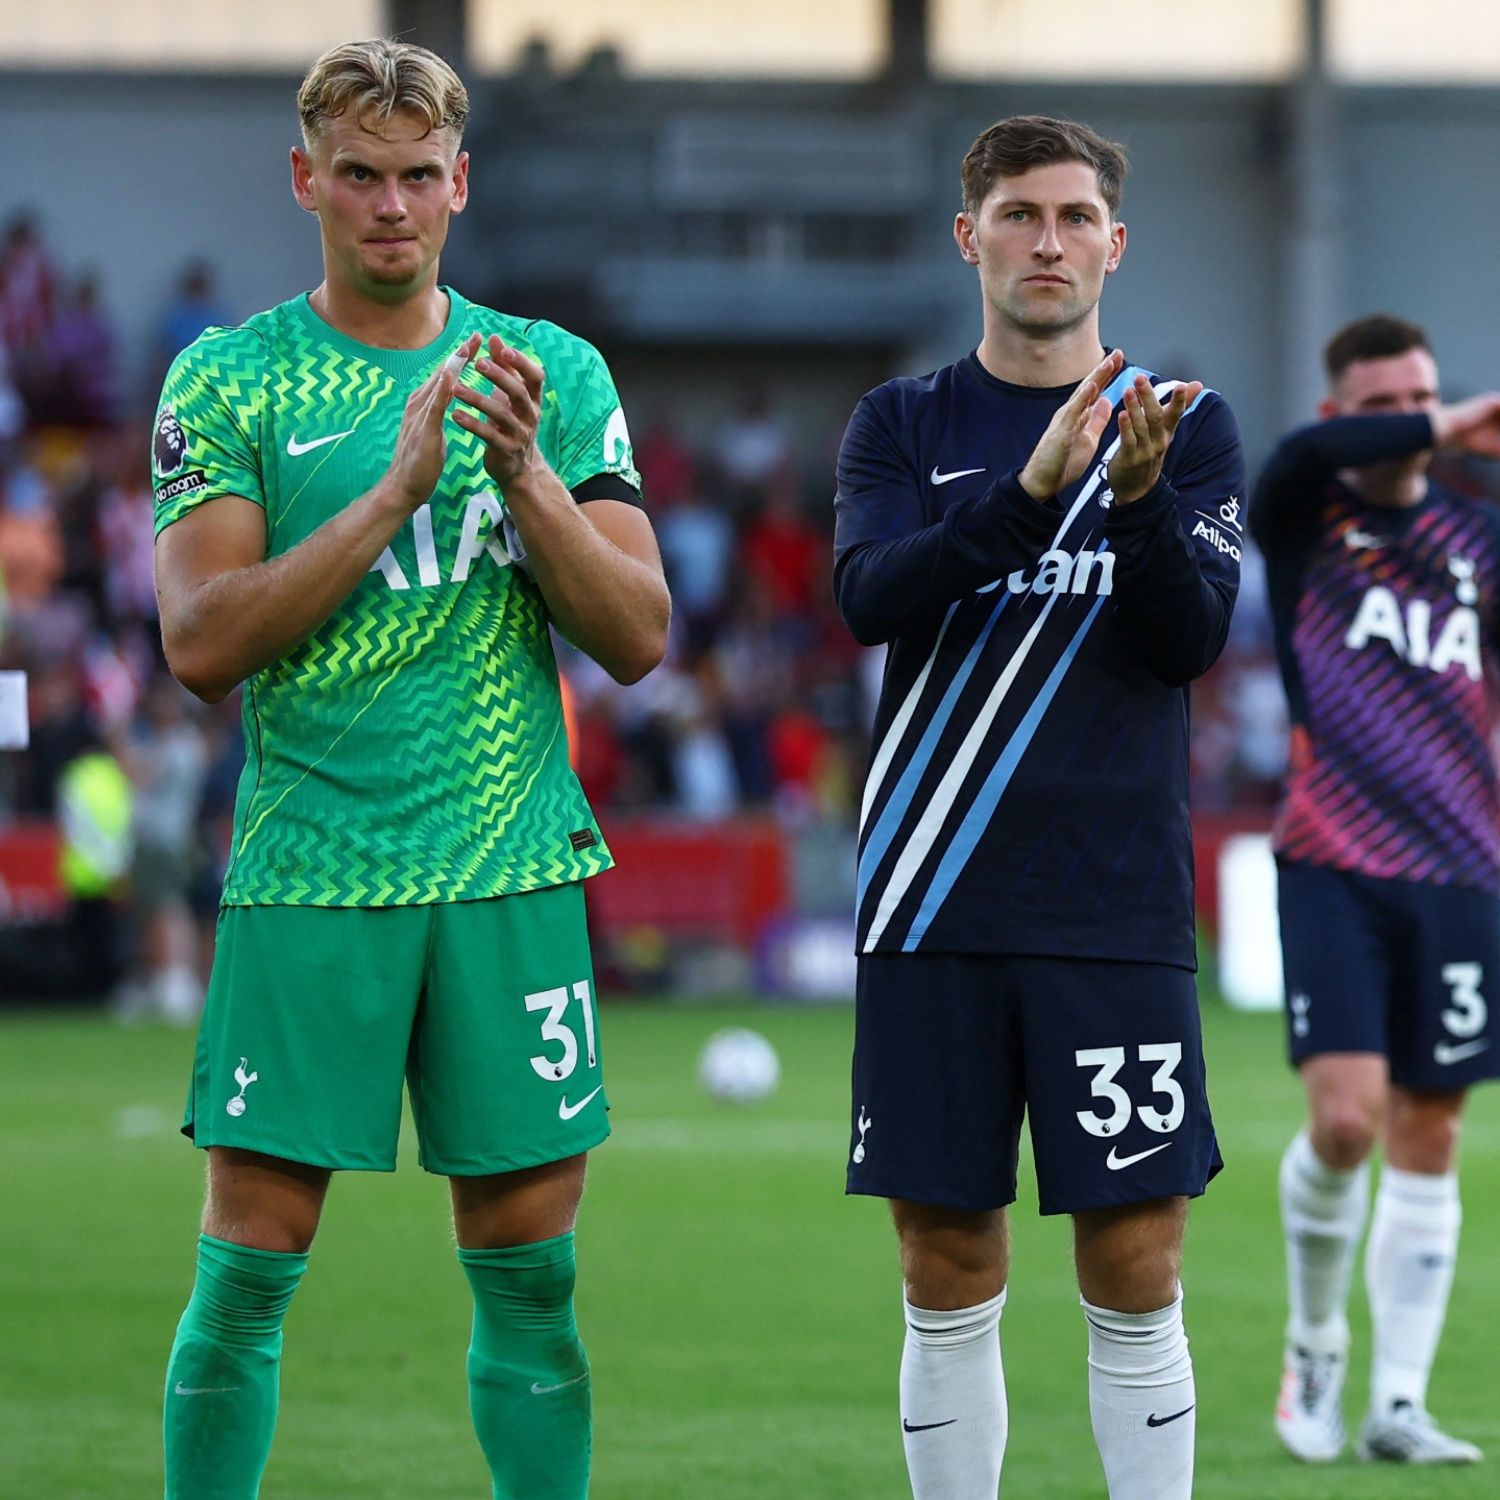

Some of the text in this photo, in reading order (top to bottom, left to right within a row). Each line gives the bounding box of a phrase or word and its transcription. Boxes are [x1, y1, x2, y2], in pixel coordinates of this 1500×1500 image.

[167, 474, 200, 496] room
[1344, 585, 1484, 682] AIA
[524, 979, 597, 1082] 31
[1441, 961, 1488, 1039] 3
[1075, 1041, 1185, 1138] 33
